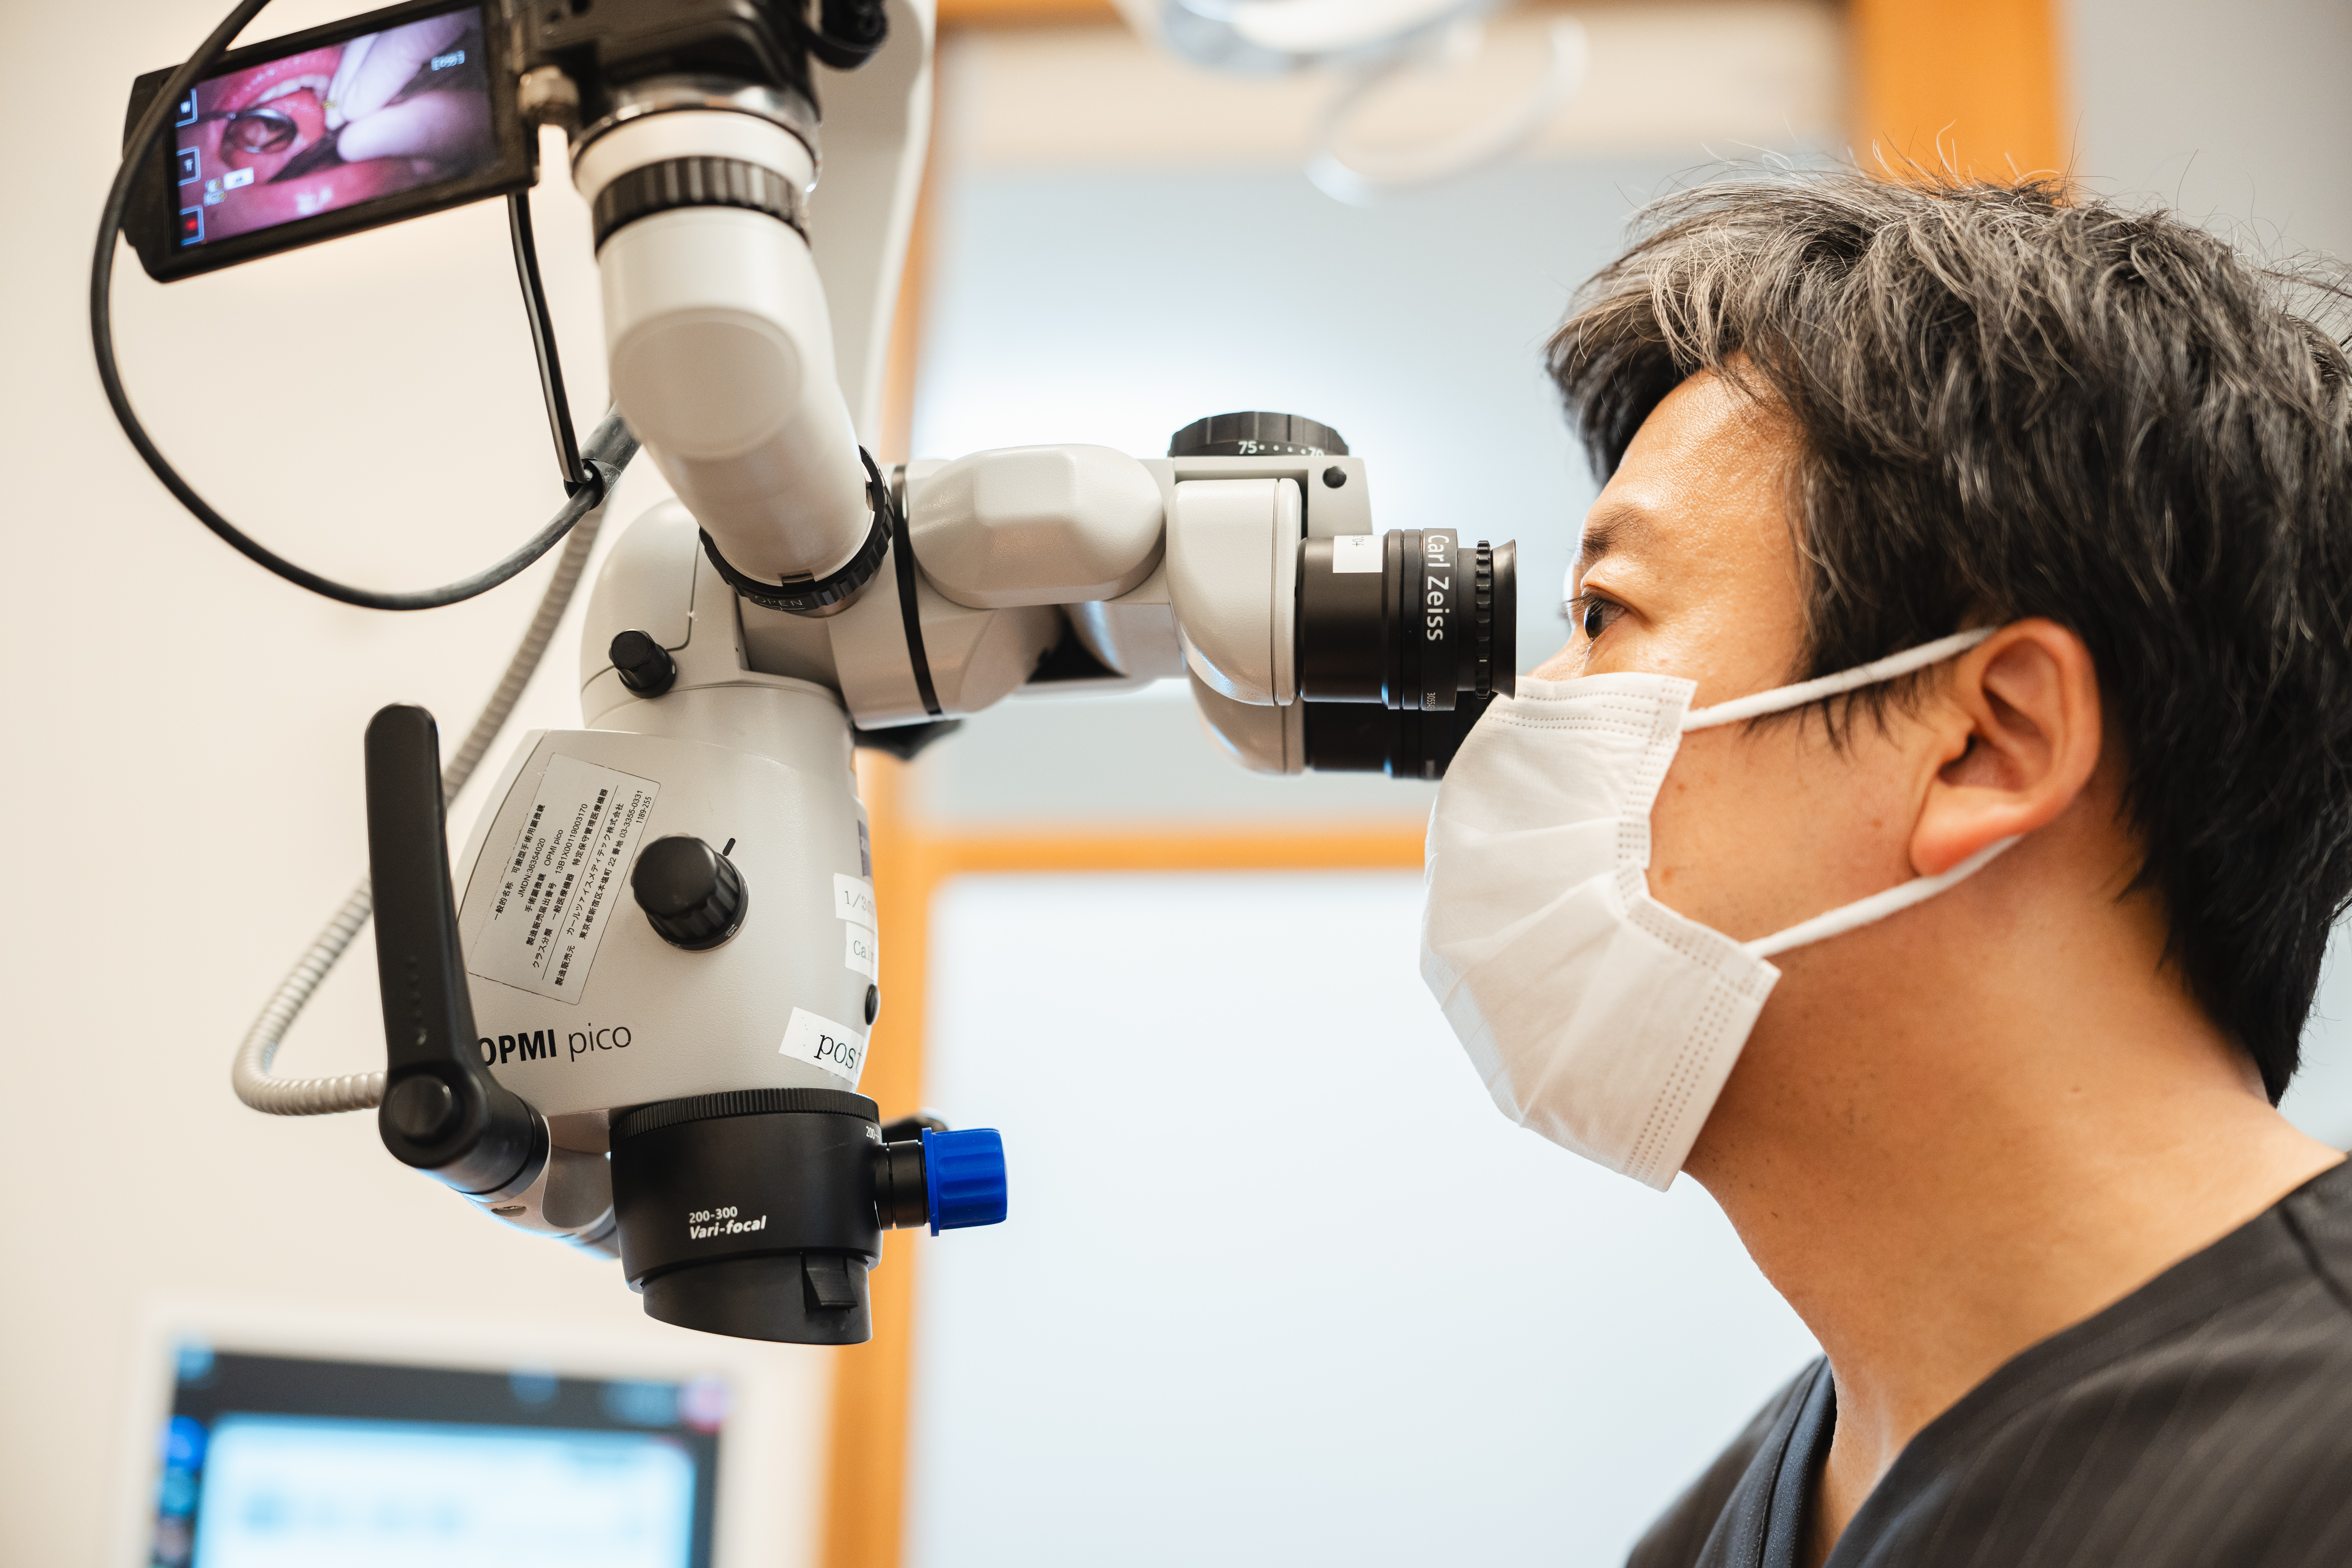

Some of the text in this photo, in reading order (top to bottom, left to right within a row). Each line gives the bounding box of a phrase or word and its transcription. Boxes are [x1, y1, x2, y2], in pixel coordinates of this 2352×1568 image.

[184, 158, 193, 172] T
[1238, 440, 1257, 455] 75
[755, 596, 803, 606] OPEN
[1427, 535, 1451, 641] Carl Zeiss
[636, 796, 652, 823] 1189-255
[544, 845, 557, 866] OPMI
[553, 830, 563, 845] pico
[579, 790, 643, 940] 東京都新宿区本塩町 22 番地 03-3355-0331
[517, 838, 546, 898] JMDN:36354020
[526, 803, 588, 946] 製造販売届出番号 13B1X00119003170
[532, 788, 609, 968] クラス分類 一般医療機器 特定保守管理医療機器
[566, 803, 624, 936] カールツァイスメディテック株式会社
[494, 881, 514, 920] 一般的名称
[555, 945, 576, 986] 製造販売元
[477, 1022, 632, 1066] OPMI pico
[866, 1125, 875, 1140] 200
[689, 1206, 738, 1224] 200-300
[690, 1215, 767, 1240] Vari-focal
